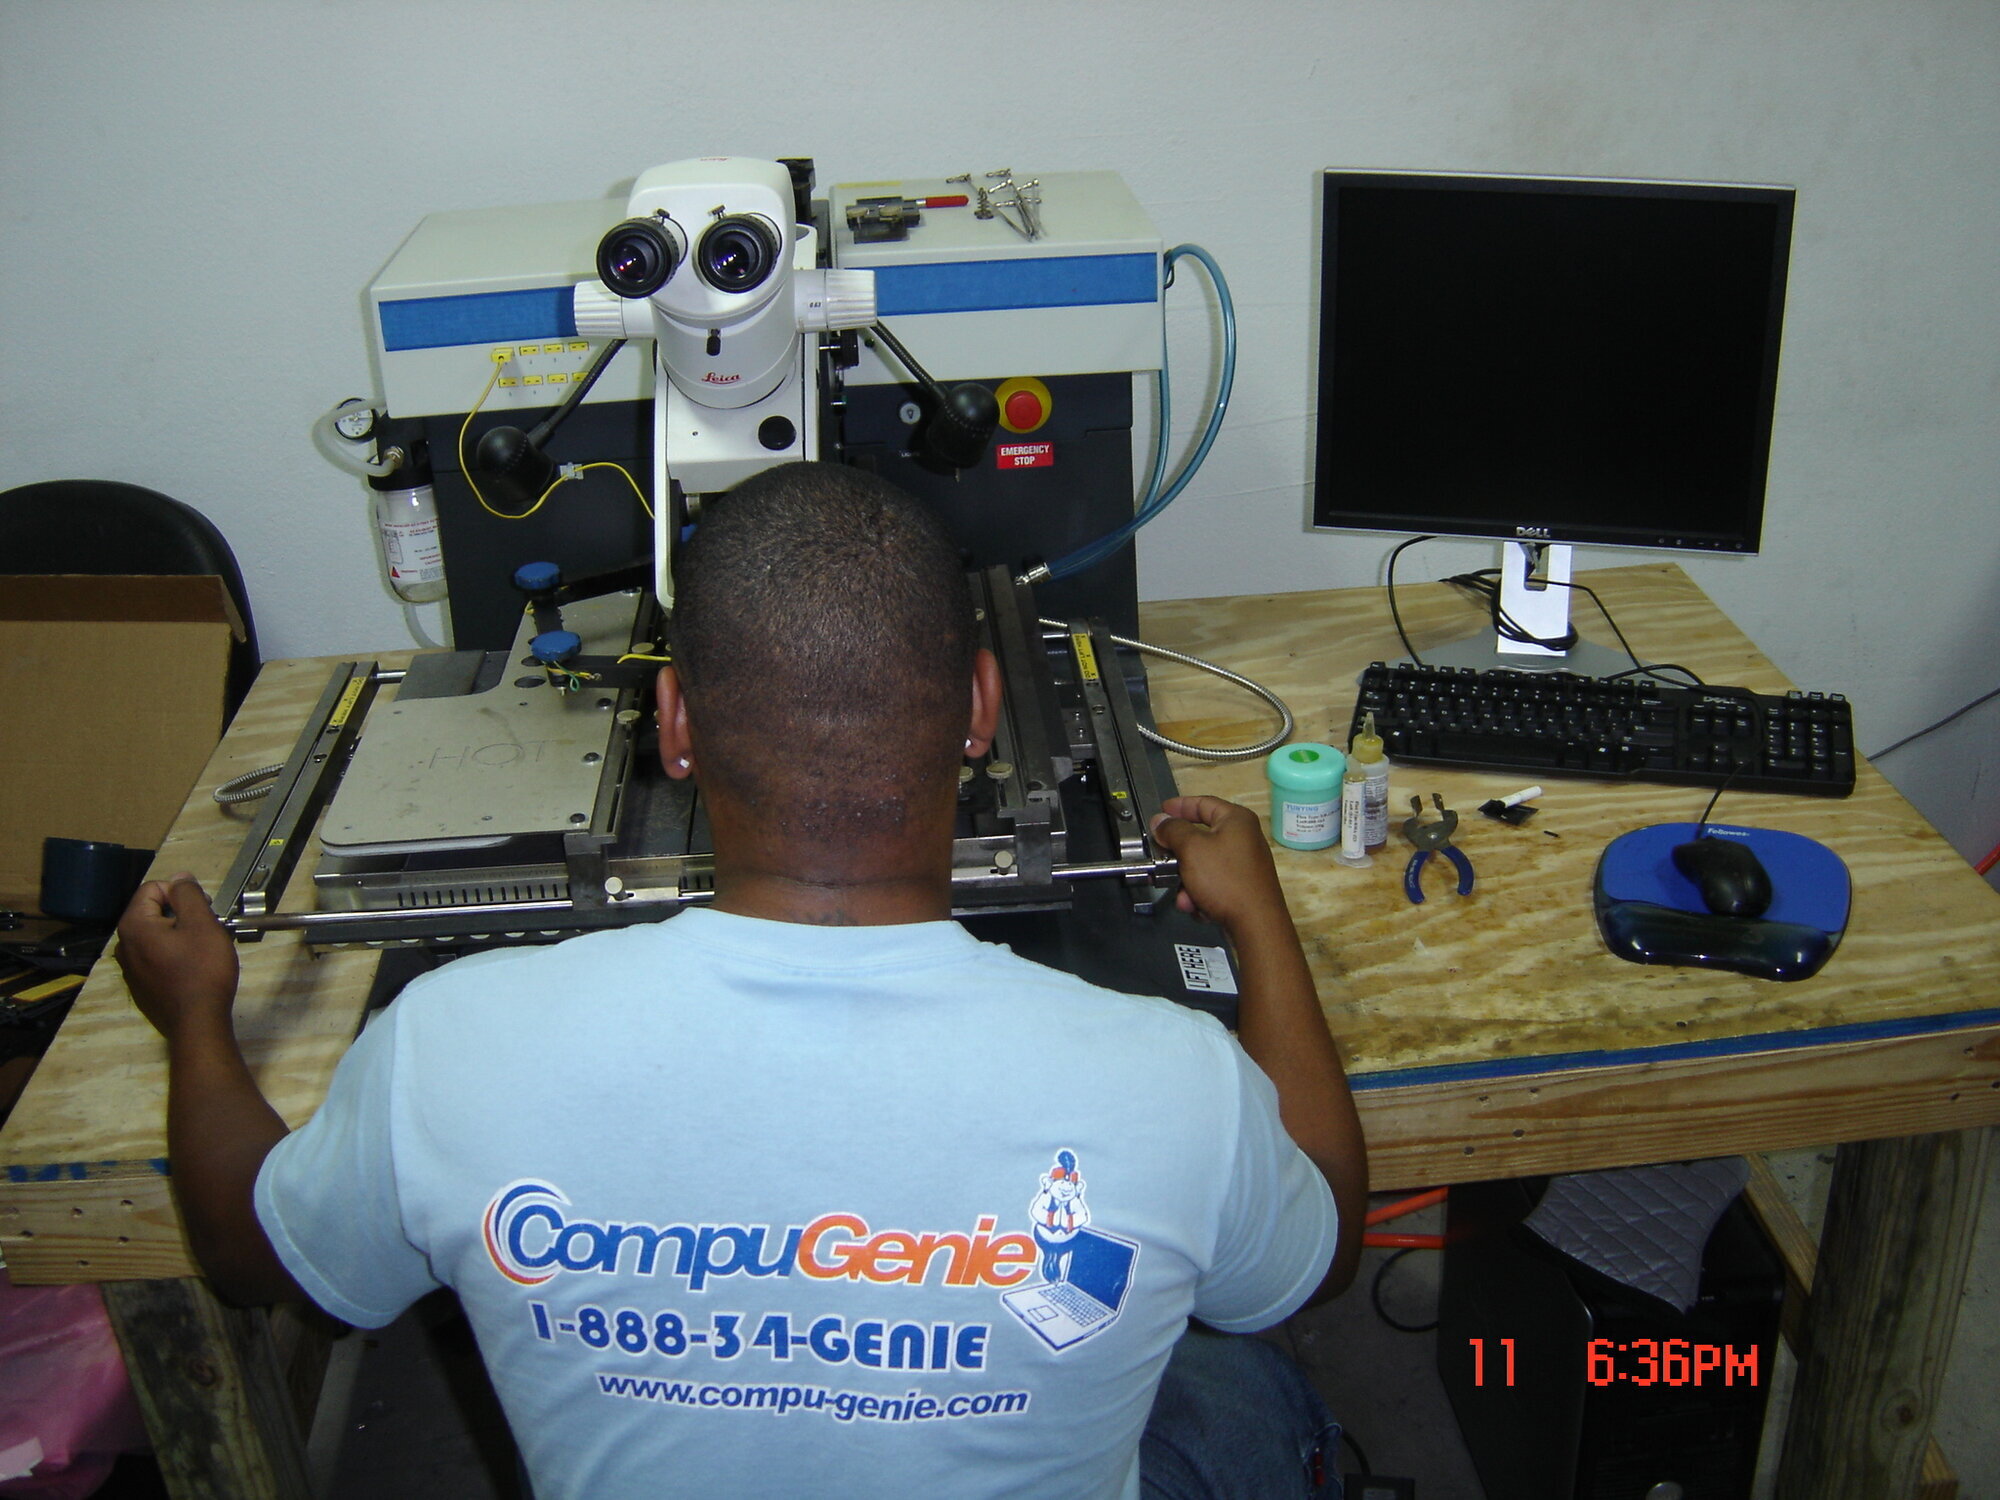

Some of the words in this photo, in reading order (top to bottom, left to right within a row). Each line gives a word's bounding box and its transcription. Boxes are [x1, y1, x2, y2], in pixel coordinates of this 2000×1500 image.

[701, 371, 741, 385] Leica
[1001, 444, 1050, 456] EMERGENCY
[1014, 456, 1035, 466] STOP
[1516, 526, 1550, 538] DELL
[429, 740, 560, 769] HOT
[1178, 946, 1206, 970] HERE
[1184, 969, 1211, 989] LIFT
[506, 1204, 1037, 1290] CompuGenie
[599, 1374, 1028, 1420] www.compu-genie.com
